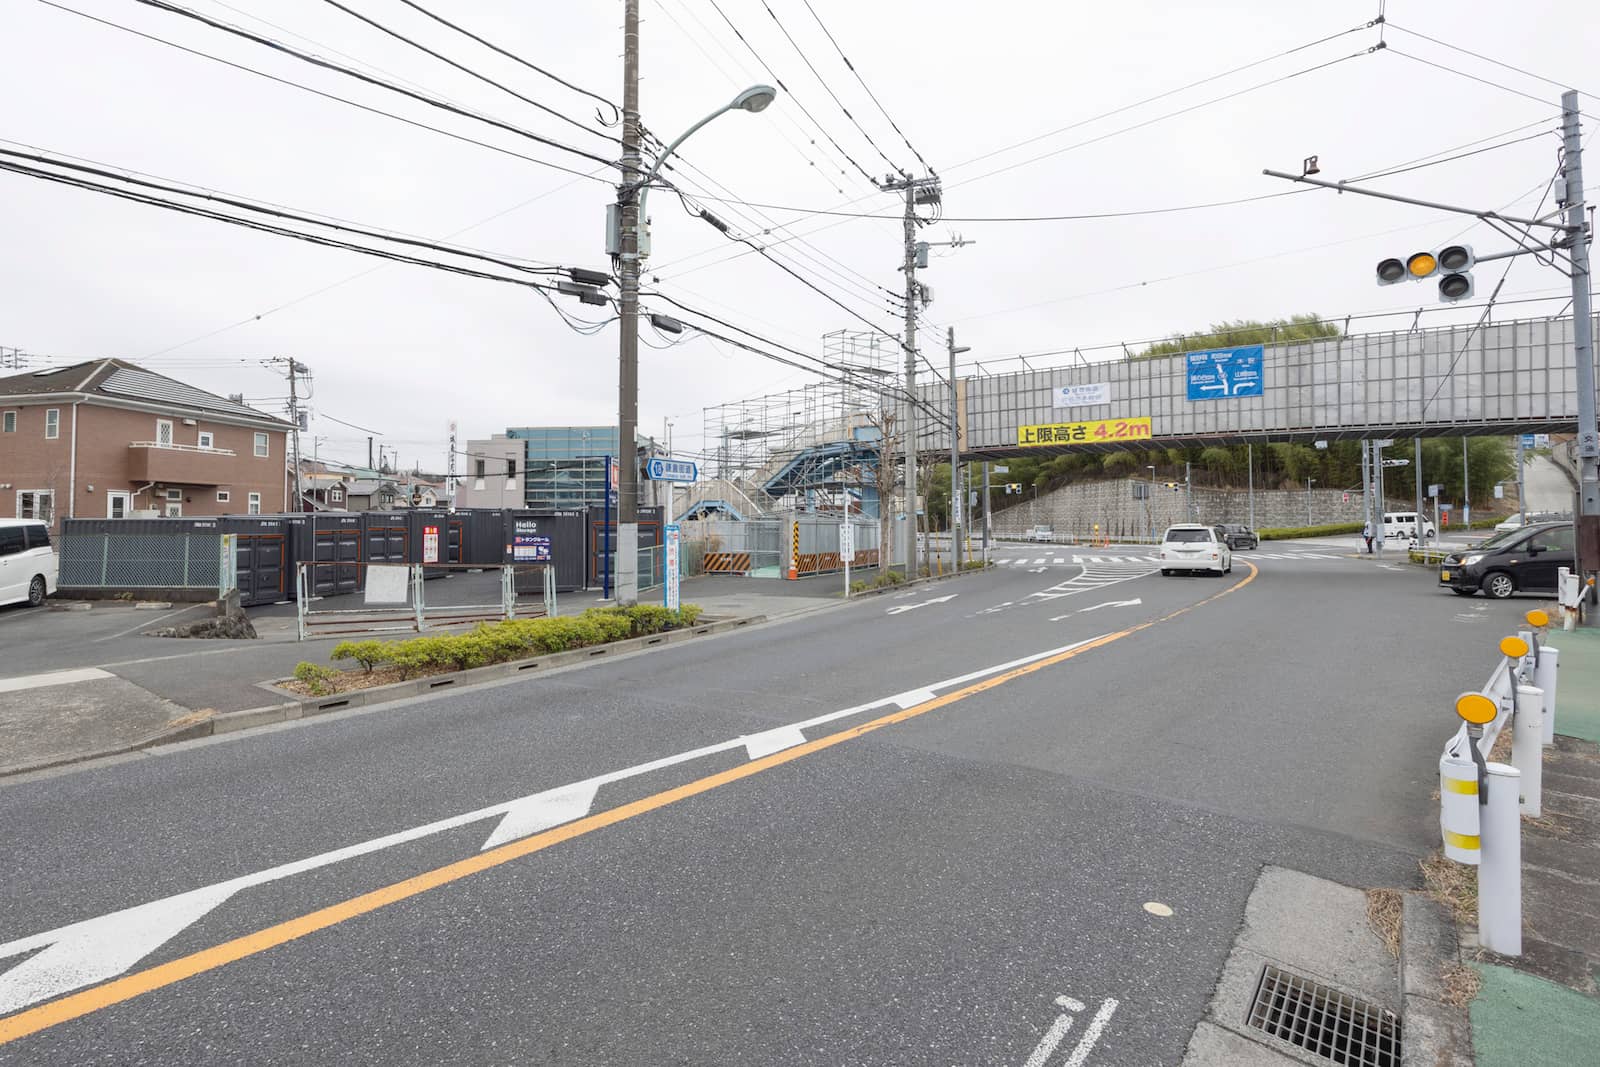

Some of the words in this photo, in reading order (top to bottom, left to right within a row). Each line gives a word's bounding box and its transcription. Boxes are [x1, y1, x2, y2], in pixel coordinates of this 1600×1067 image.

[1020, 425, 1087, 444] 上限高さ
[1094, 421, 1149, 438] 4.2m
